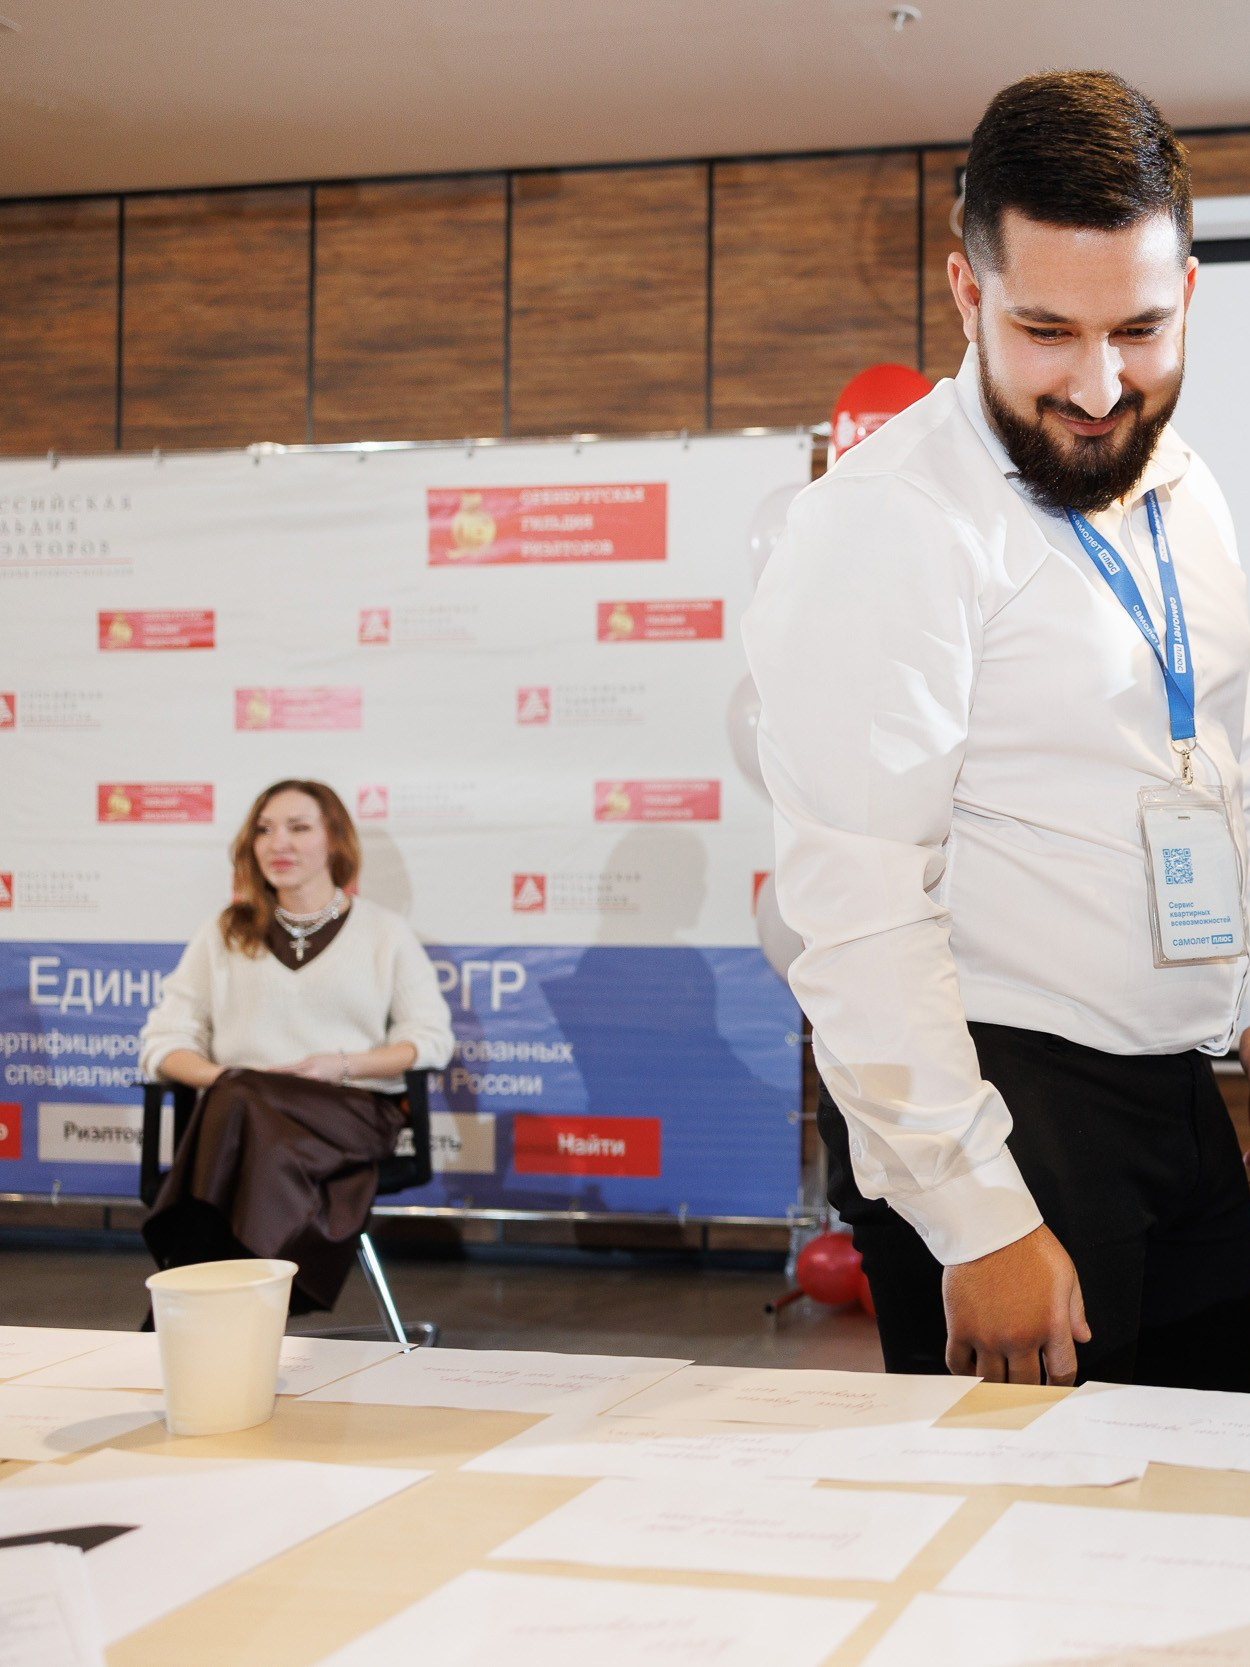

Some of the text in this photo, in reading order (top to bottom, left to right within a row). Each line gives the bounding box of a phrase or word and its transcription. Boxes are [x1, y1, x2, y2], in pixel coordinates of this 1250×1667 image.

[0, 493, 132, 512] ССИЙСКАЯ
[0, 518, 78, 536] ЛЬДИЯ
[1072, 514, 1102, 551] самолет
[0, 539, 111, 557] ЭЛТОРОВ
[1170, 910, 1210, 918] квартирных
[1171, 916, 1231, 926] всевозможностей
[1173, 936, 1210, 946] самолет
[0, 1028, 573, 1063] ртифициро тованных
[450, 1068, 543, 1096] России
[558, 1133, 625, 1157] Найти
